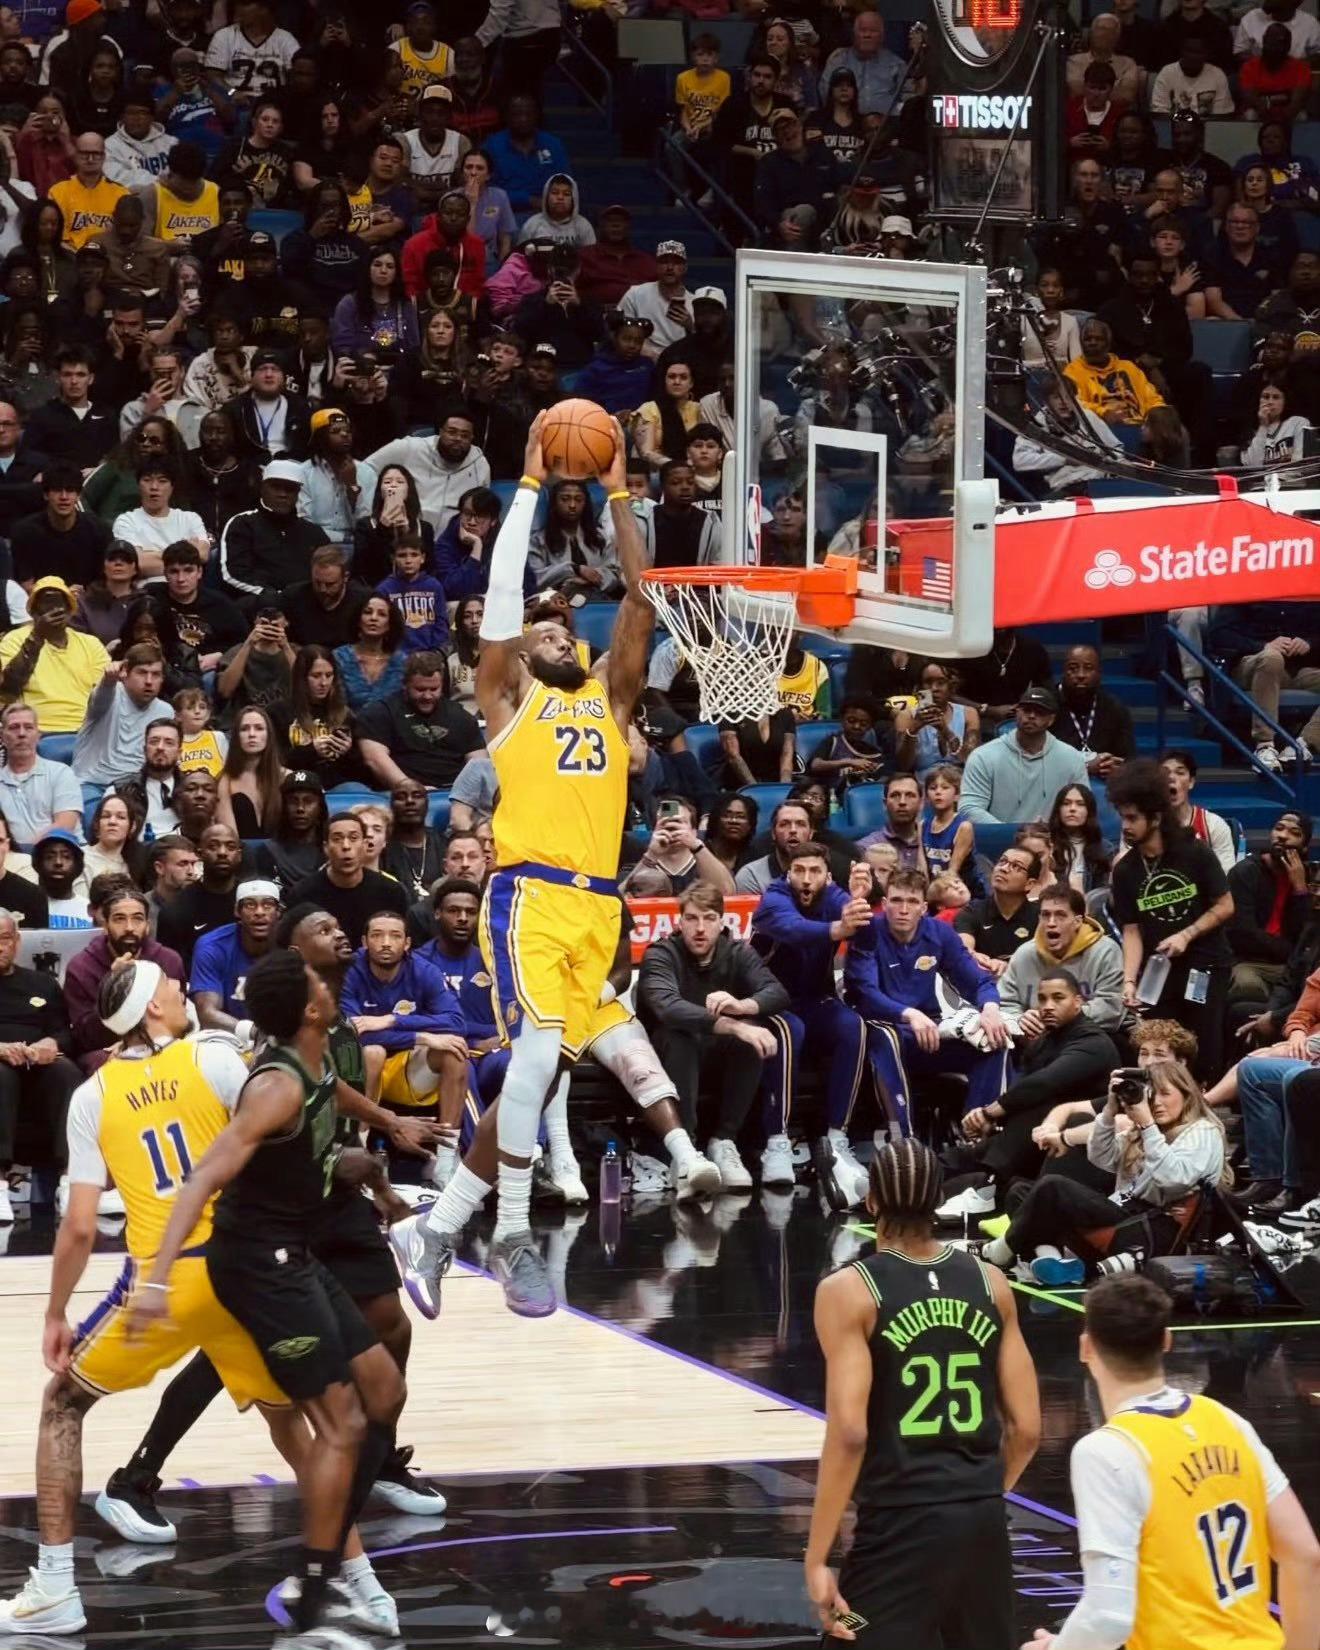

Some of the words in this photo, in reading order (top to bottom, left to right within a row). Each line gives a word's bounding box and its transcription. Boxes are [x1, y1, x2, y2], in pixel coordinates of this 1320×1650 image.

[957, 96, 1031, 129] TISSOT
[72, 211, 114, 232] LAKERS
[168, 213, 212, 229] LAKERS
[397, 597, 436, 625] AKERS
[180, 749, 214, 765] AKERS
[554, 725, 608, 776] 23
[1142, 887, 1194, 909] PELICANS
[125, 1079, 178, 1113] HAYES
[141, 1121, 195, 1196] 11
[882, 1298, 968, 1351] MURPHY
[967, 1309, 999, 1348] III
[900, 1353, 983, 1436] 25
[1197, 1499, 1259, 1610] 12
